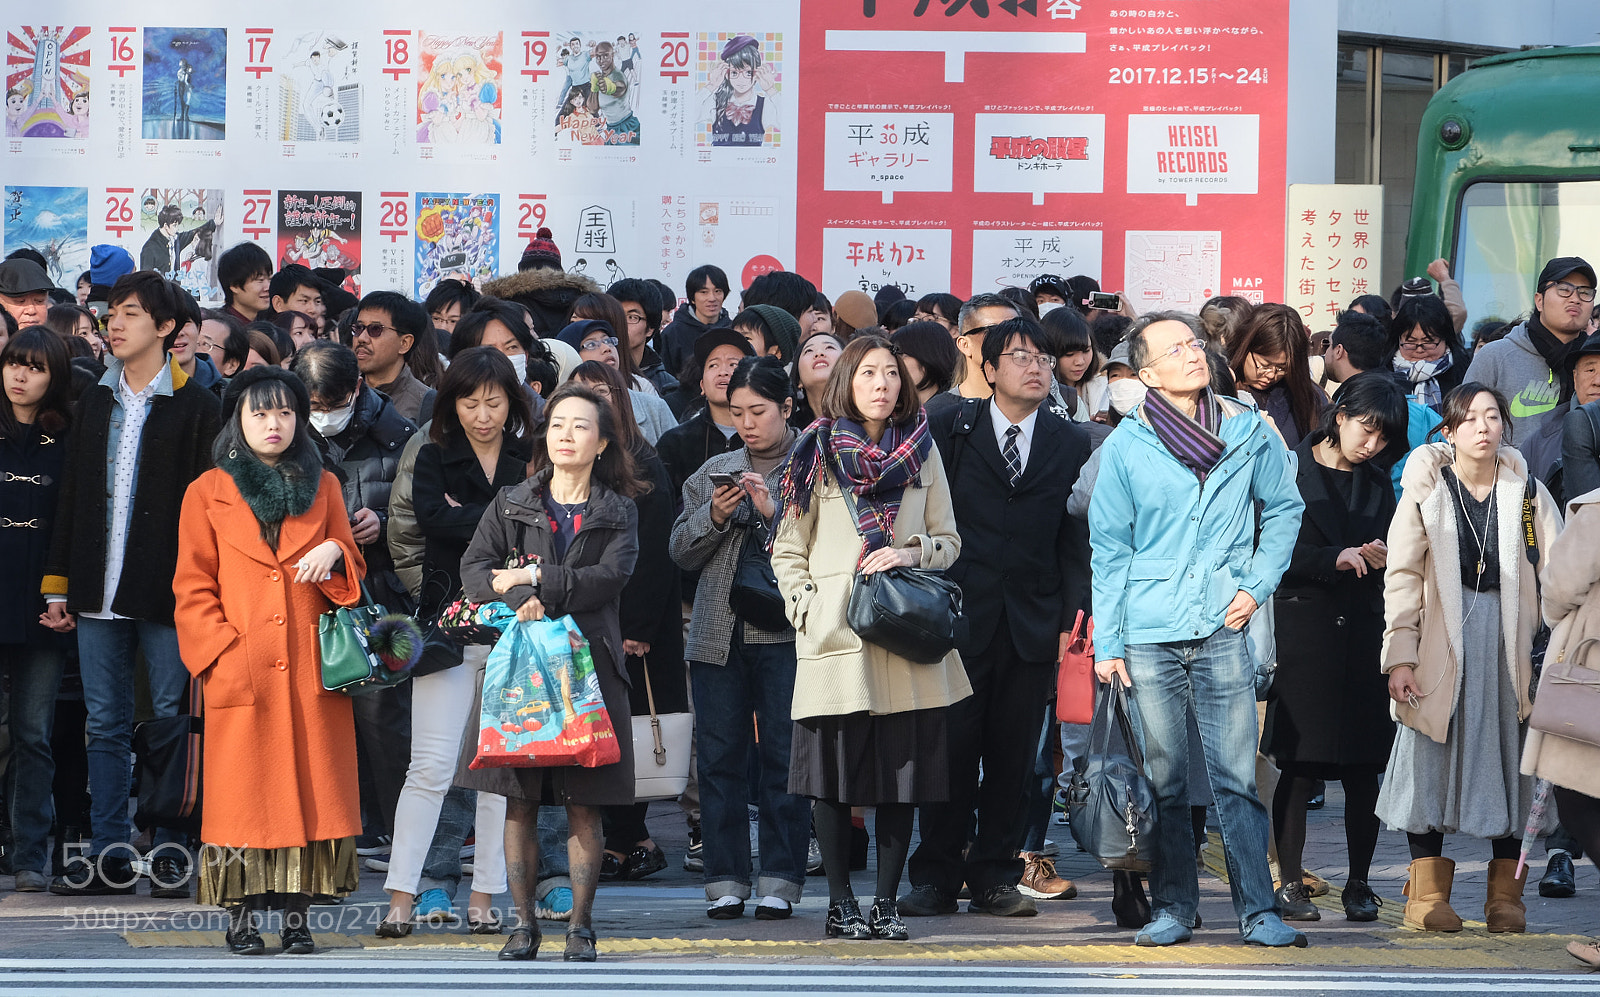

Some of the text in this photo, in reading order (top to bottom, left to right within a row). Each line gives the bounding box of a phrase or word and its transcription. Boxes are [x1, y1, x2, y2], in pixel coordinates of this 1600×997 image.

[1109, 10, 1180, 18] あの時の自分と、
[1109, 27, 1264, 35] 懐かしいあの人を思い浮かべながら、
[44, 42, 53, 75] OPEN
[111, 36, 134, 61] 16
[247, 37, 271, 62] 17
[385, 39, 409, 65] 18
[523, 40, 547, 66] 19
[660, 41, 689, 67] 20
[1108, 67, 1209, 84] 2017.12.15
[559, 115, 607, 130] Happy
[570, 129, 637, 144] New Year
[880, 133, 898, 145] 30
[1168, 125, 1218, 147] HEISEI
[848, 151, 929, 168] ギャラリー
[1157, 151, 1228, 173] RECORDS
[871, 174, 904, 182] n_space
[105, 197, 134, 222] 26
[243, 199, 271, 224] 27
[422, 197, 494, 206] HAPPY NEW YEAR
[380, 201, 408, 227] 28
[518, 203, 547, 229] 29
[661, 195, 672, 278] 購入できます。
[676, 195, 686, 259] こちらから
[1001, 256, 1075, 268] オンステージ
[1351, 209, 1370, 294] 世界の渋
[882, 269, 892, 278] by
[1298, 208, 1317, 328] 考えた街づ
[1326, 209, 1342, 327] タウンセキ
[1035, 277, 1057, 287] NYC
[1232, 277, 1263, 288] MAP
[1526, 522, 1536, 546] Nikon
[562, 728, 613, 747] new york
